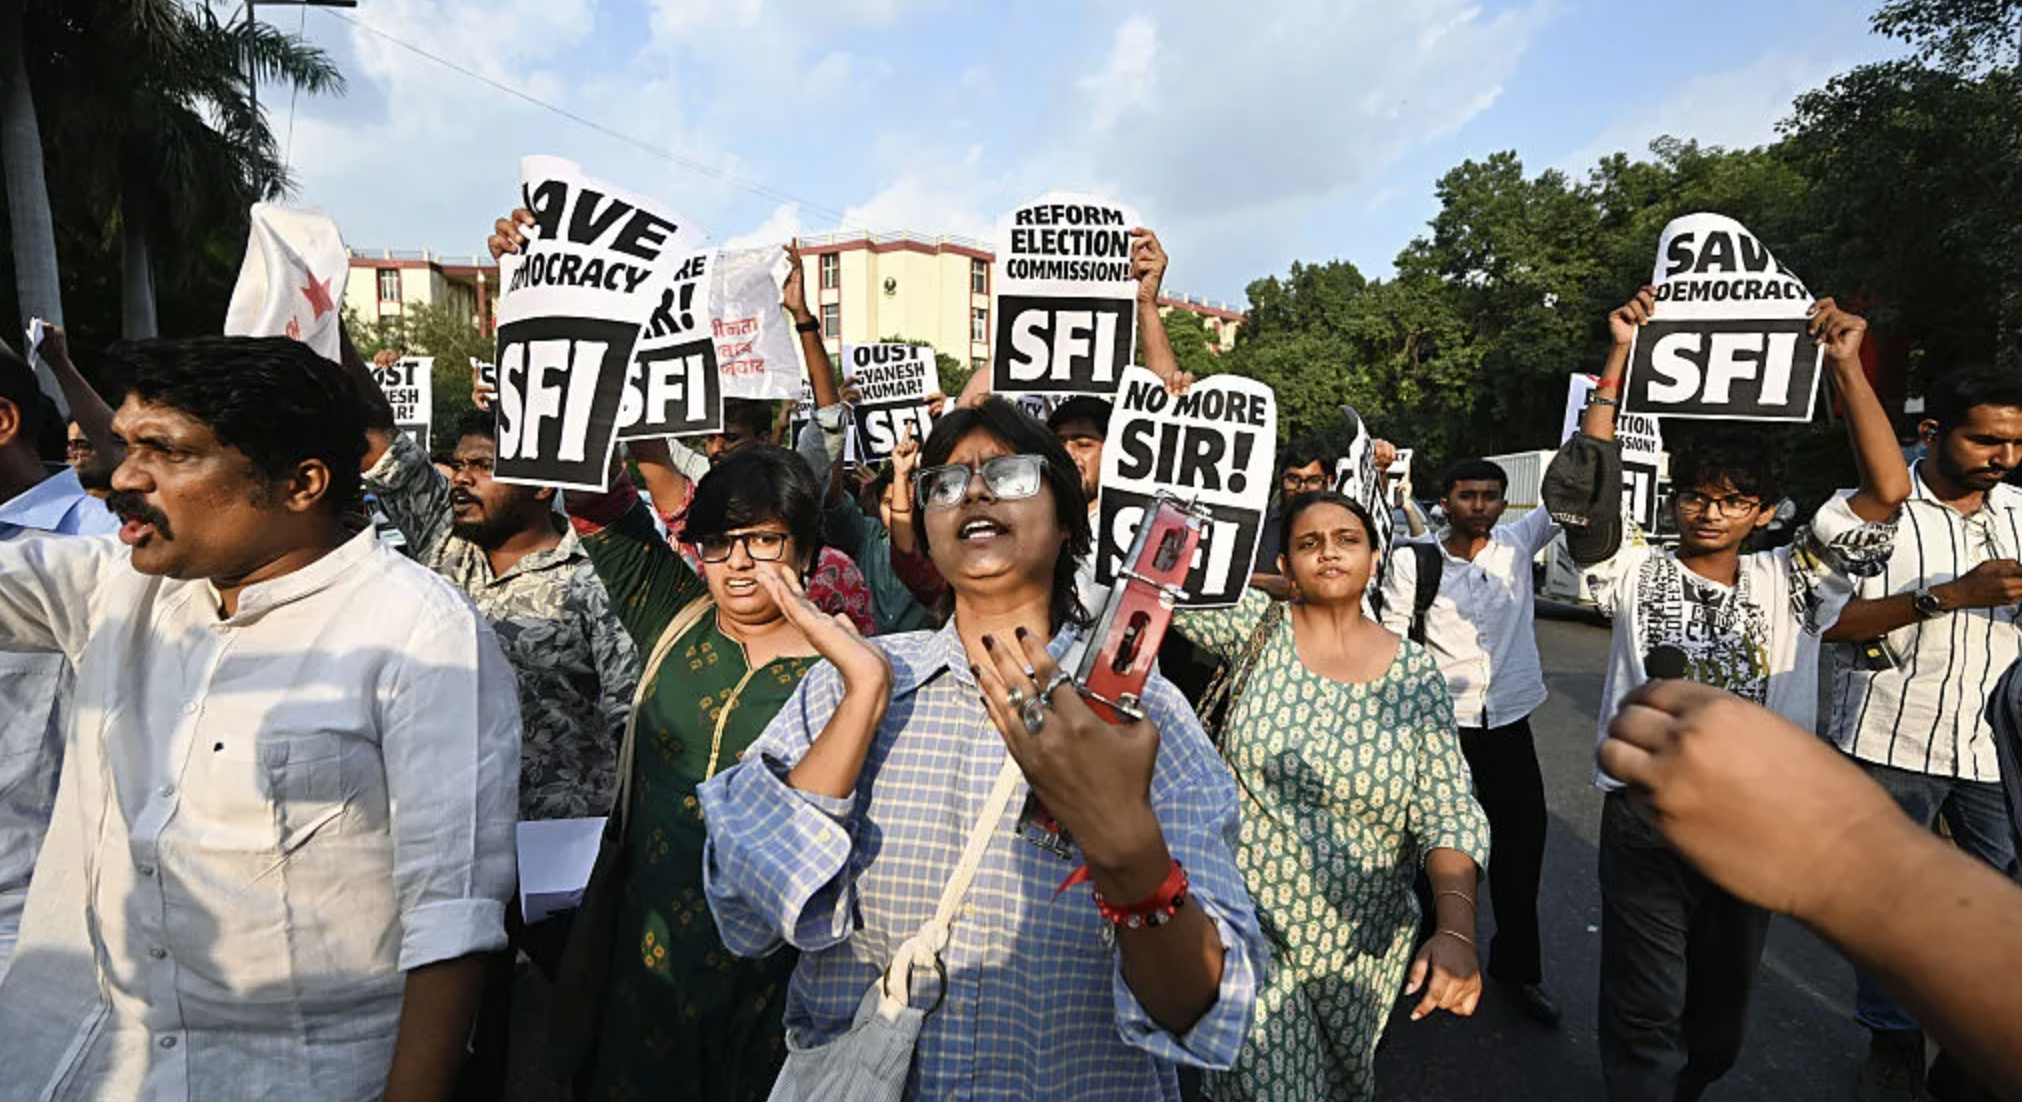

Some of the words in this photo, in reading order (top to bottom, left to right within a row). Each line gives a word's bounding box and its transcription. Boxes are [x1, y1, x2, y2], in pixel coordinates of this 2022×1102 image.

[522, 179, 678, 262] AVE
[1015, 204, 1124, 226] REFORM
[1011, 228, 1129, 258] ELECTION
[1006, 258, 1130, 282] COMMISSION!
[1655, 278, 1808, 302] DEMOCRACY
[853, 344, 919, 368] OUST
[1008, 308, 1119, 382] SFI
[1647, 331, 1799, 406] SFI
[499, 338, 609, 463] SFI
[617, 353, 707, 429] SFI
[861, 378, 923, 400] KUMAR!
[1123, 380, 1169, 414] NO
[1172, 388, 1267, 428] MORE
[1618, 415, 1656, 437] TION
[1117, 418, 1256, 494] SIR!
